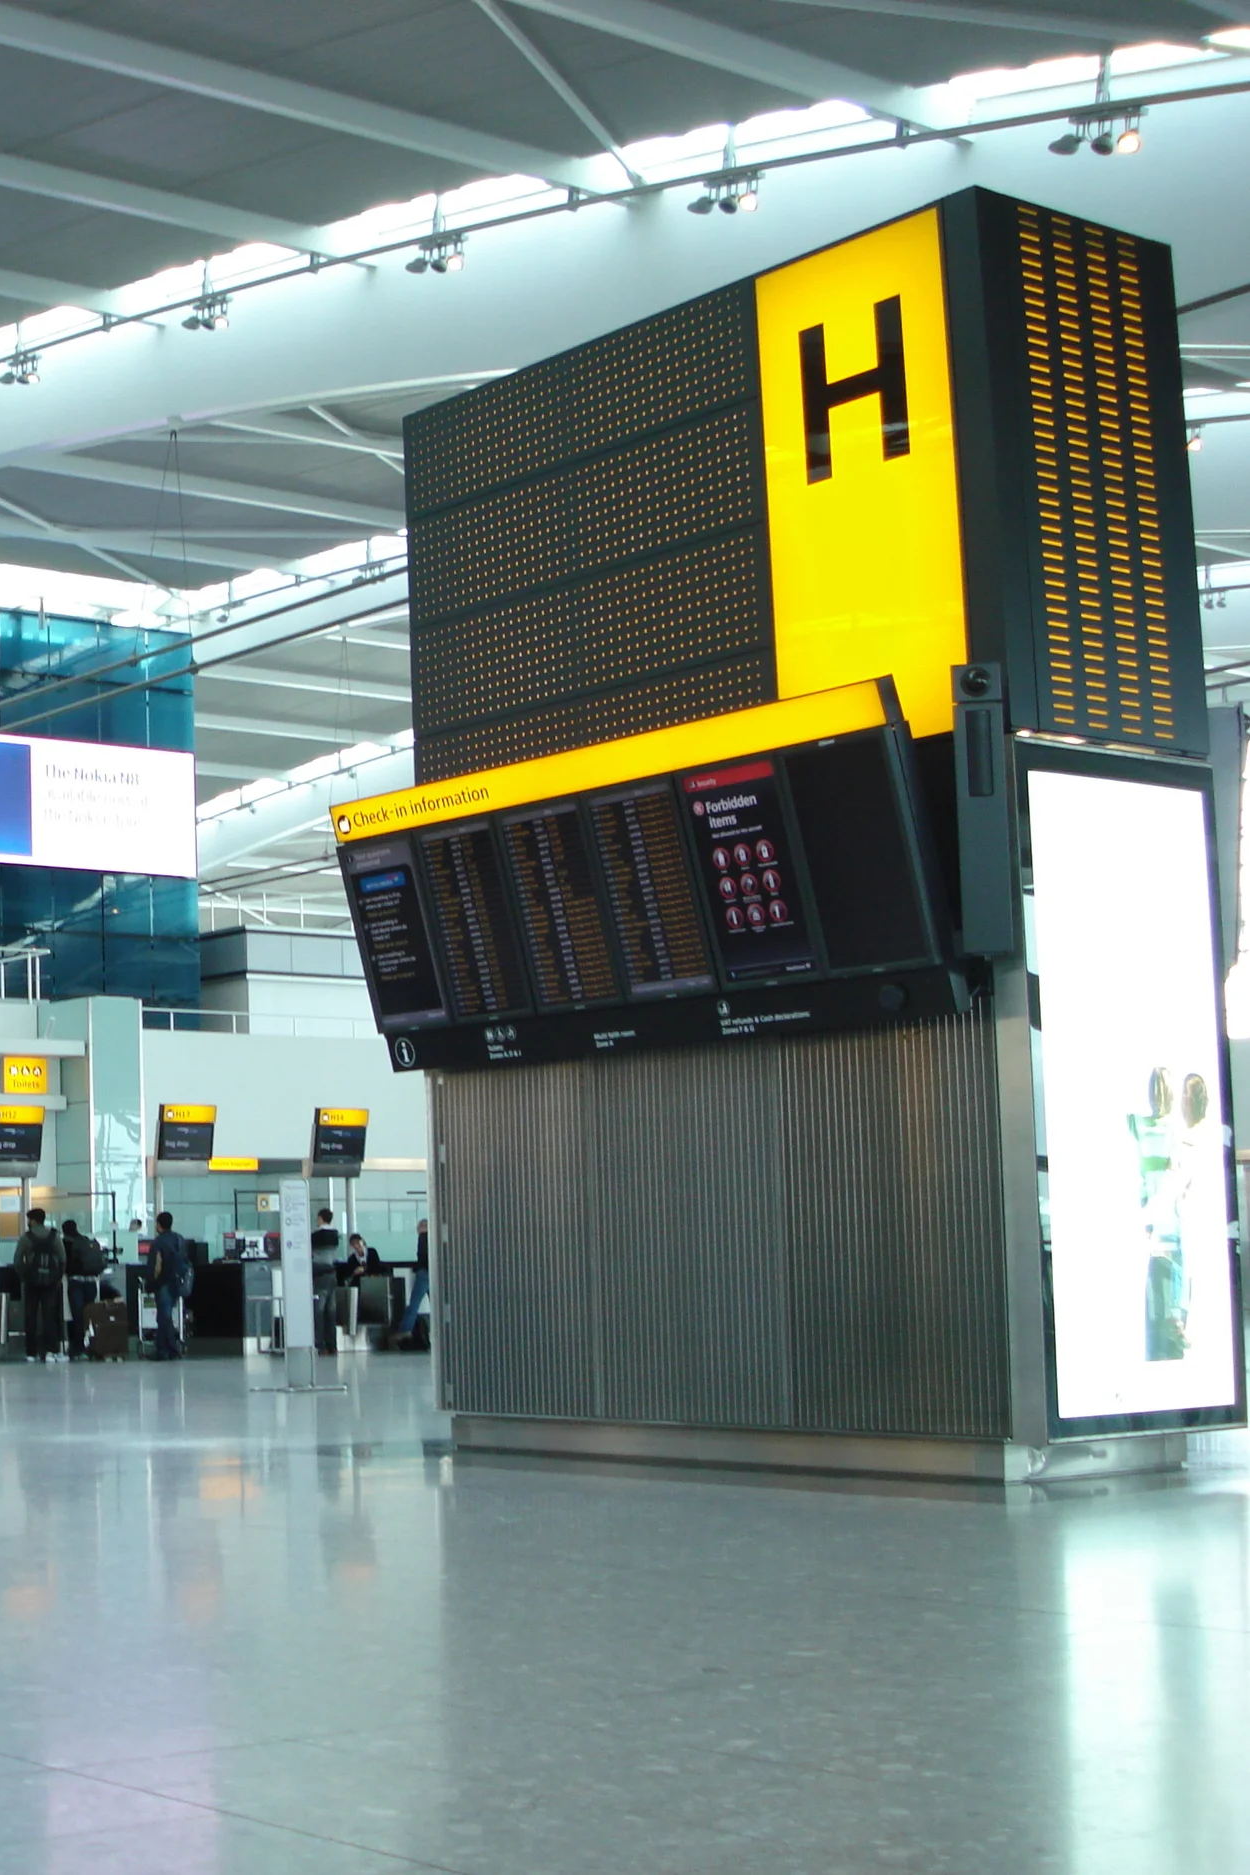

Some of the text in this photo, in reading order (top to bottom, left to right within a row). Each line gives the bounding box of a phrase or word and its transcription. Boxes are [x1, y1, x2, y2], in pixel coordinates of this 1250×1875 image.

[798, 294, 910, 485] H
[43, 764, 139, 785] The Nokia N8
[353, 786, 490, 827] Check-in information
[705, 794, 757, 814] Forbidden
[12, 1079, 40, 1089] Toilets
